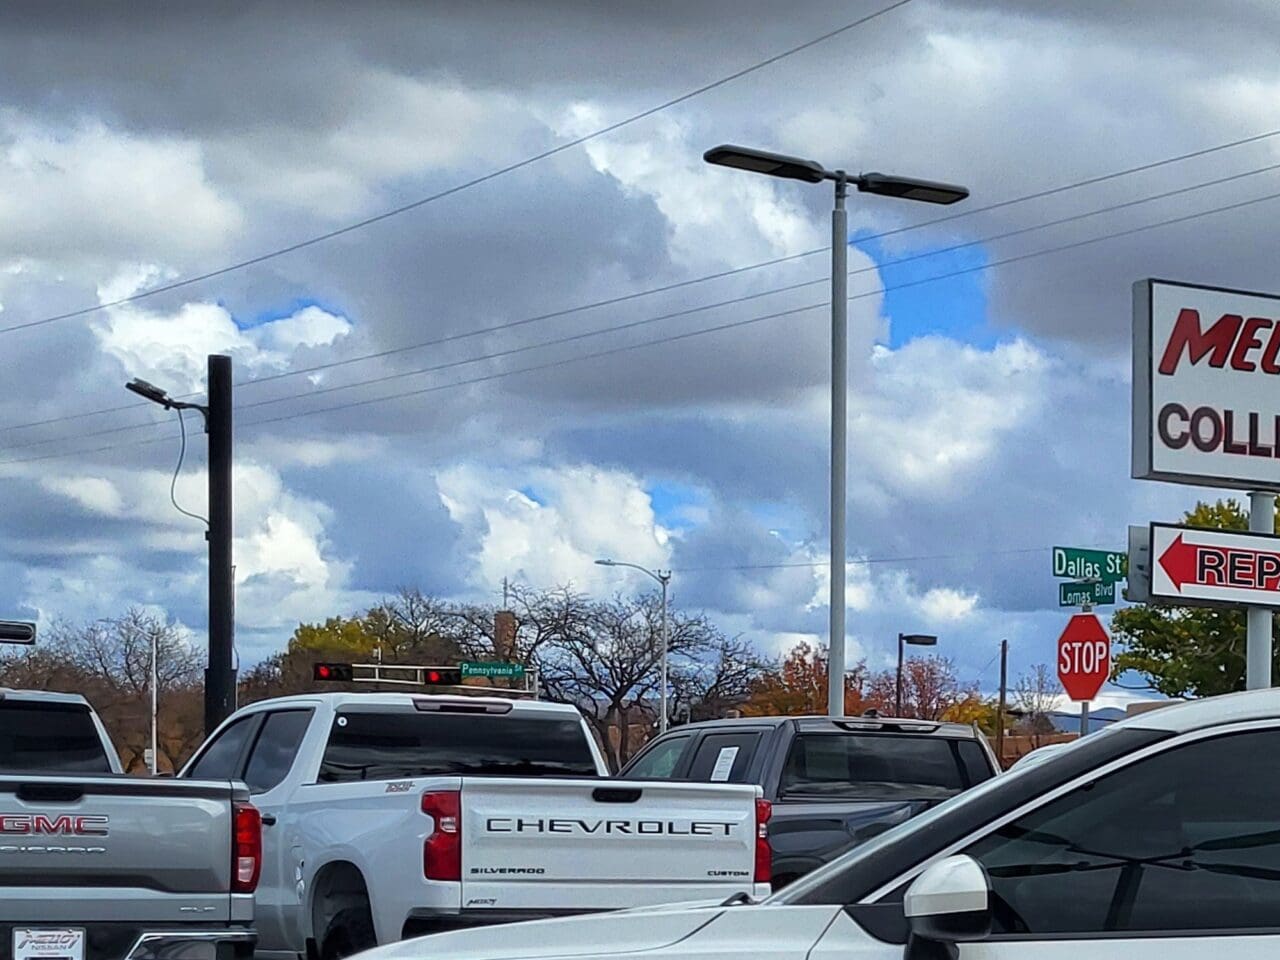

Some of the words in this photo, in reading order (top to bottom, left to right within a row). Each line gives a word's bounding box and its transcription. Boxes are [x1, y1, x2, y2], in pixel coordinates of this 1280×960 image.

[1054, 549, 1101, 578] Dallas
[1106, 554, 1122, 574] St
[1060, 584, 1092, 605] Lomas
[1095, 583, 1113, 597] Blvd
[462, 663, 513, 676] Pennsylvania
[1059, 641, 1107, 675] STOP
[0, 814, 109, 838] GMC
[486, 817, 738, 835] CHEVROLET
